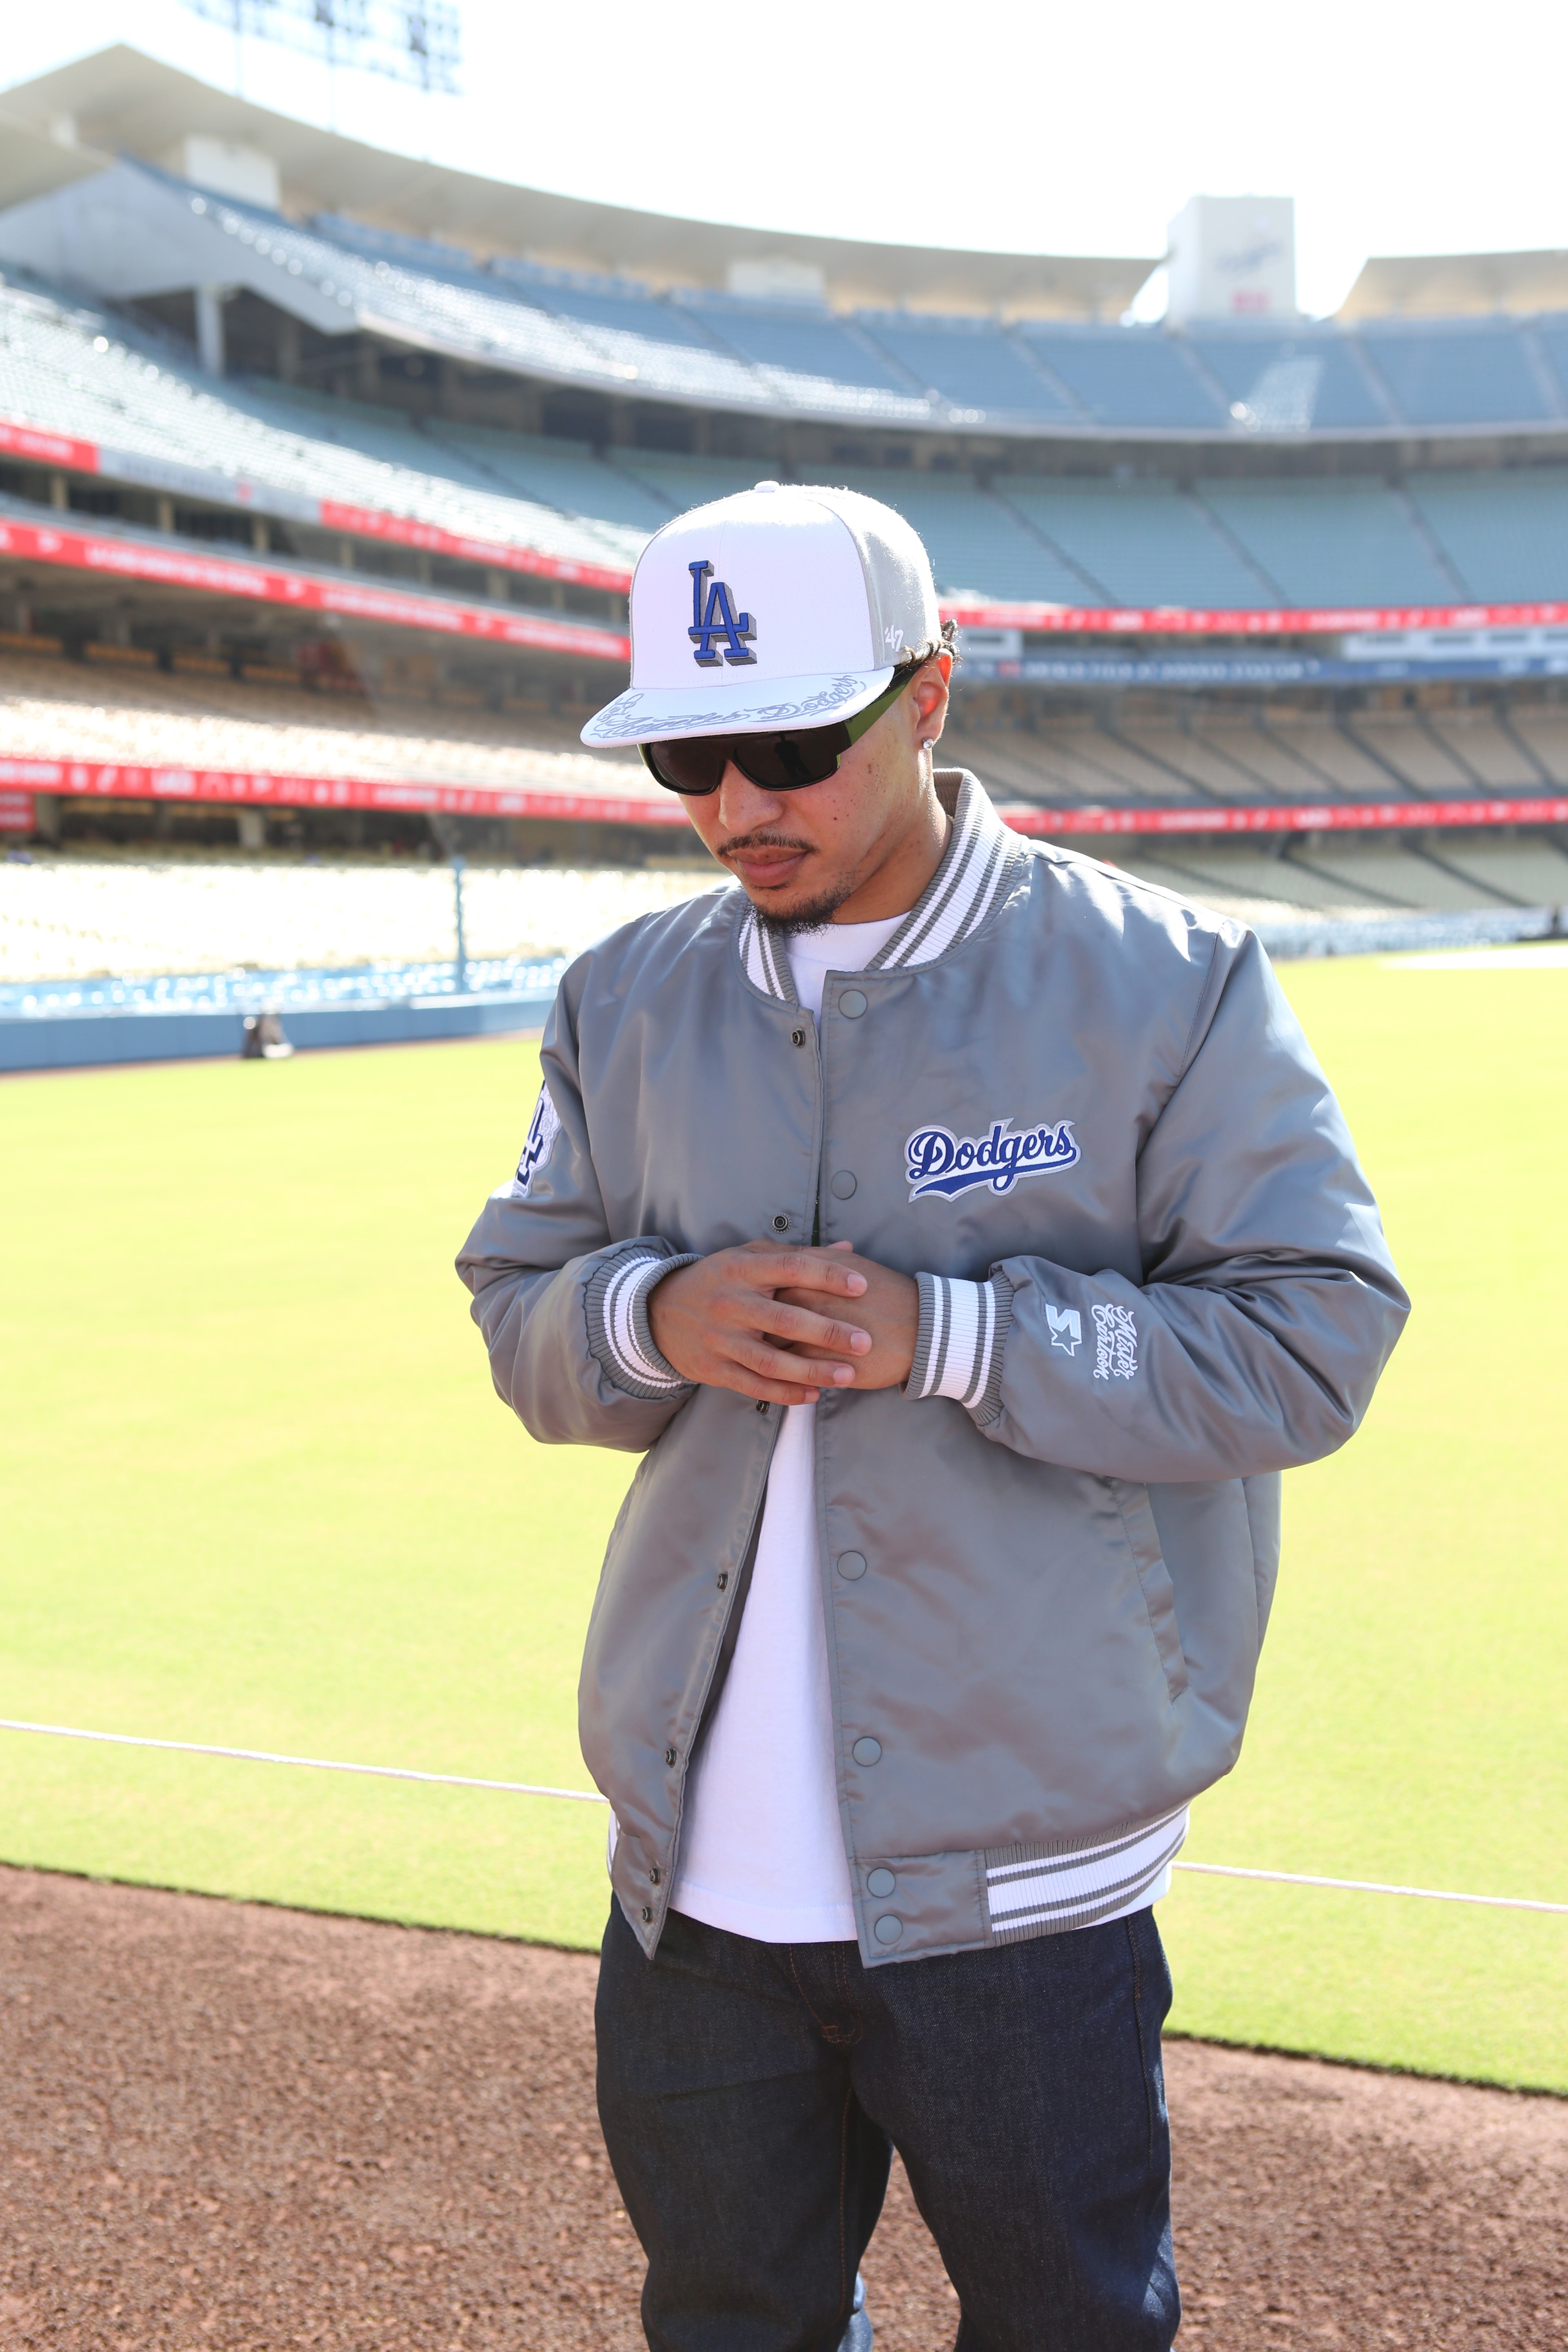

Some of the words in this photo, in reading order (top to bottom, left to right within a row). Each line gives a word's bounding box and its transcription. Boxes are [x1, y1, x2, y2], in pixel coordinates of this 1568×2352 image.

[688, 560, 757, 666] LA
[908, 1125, 1077, 1192] Dodgers
[1091, 1303, 1116, 1380] Cartoon
[1111, 1305, 1138, 1380] Mister
